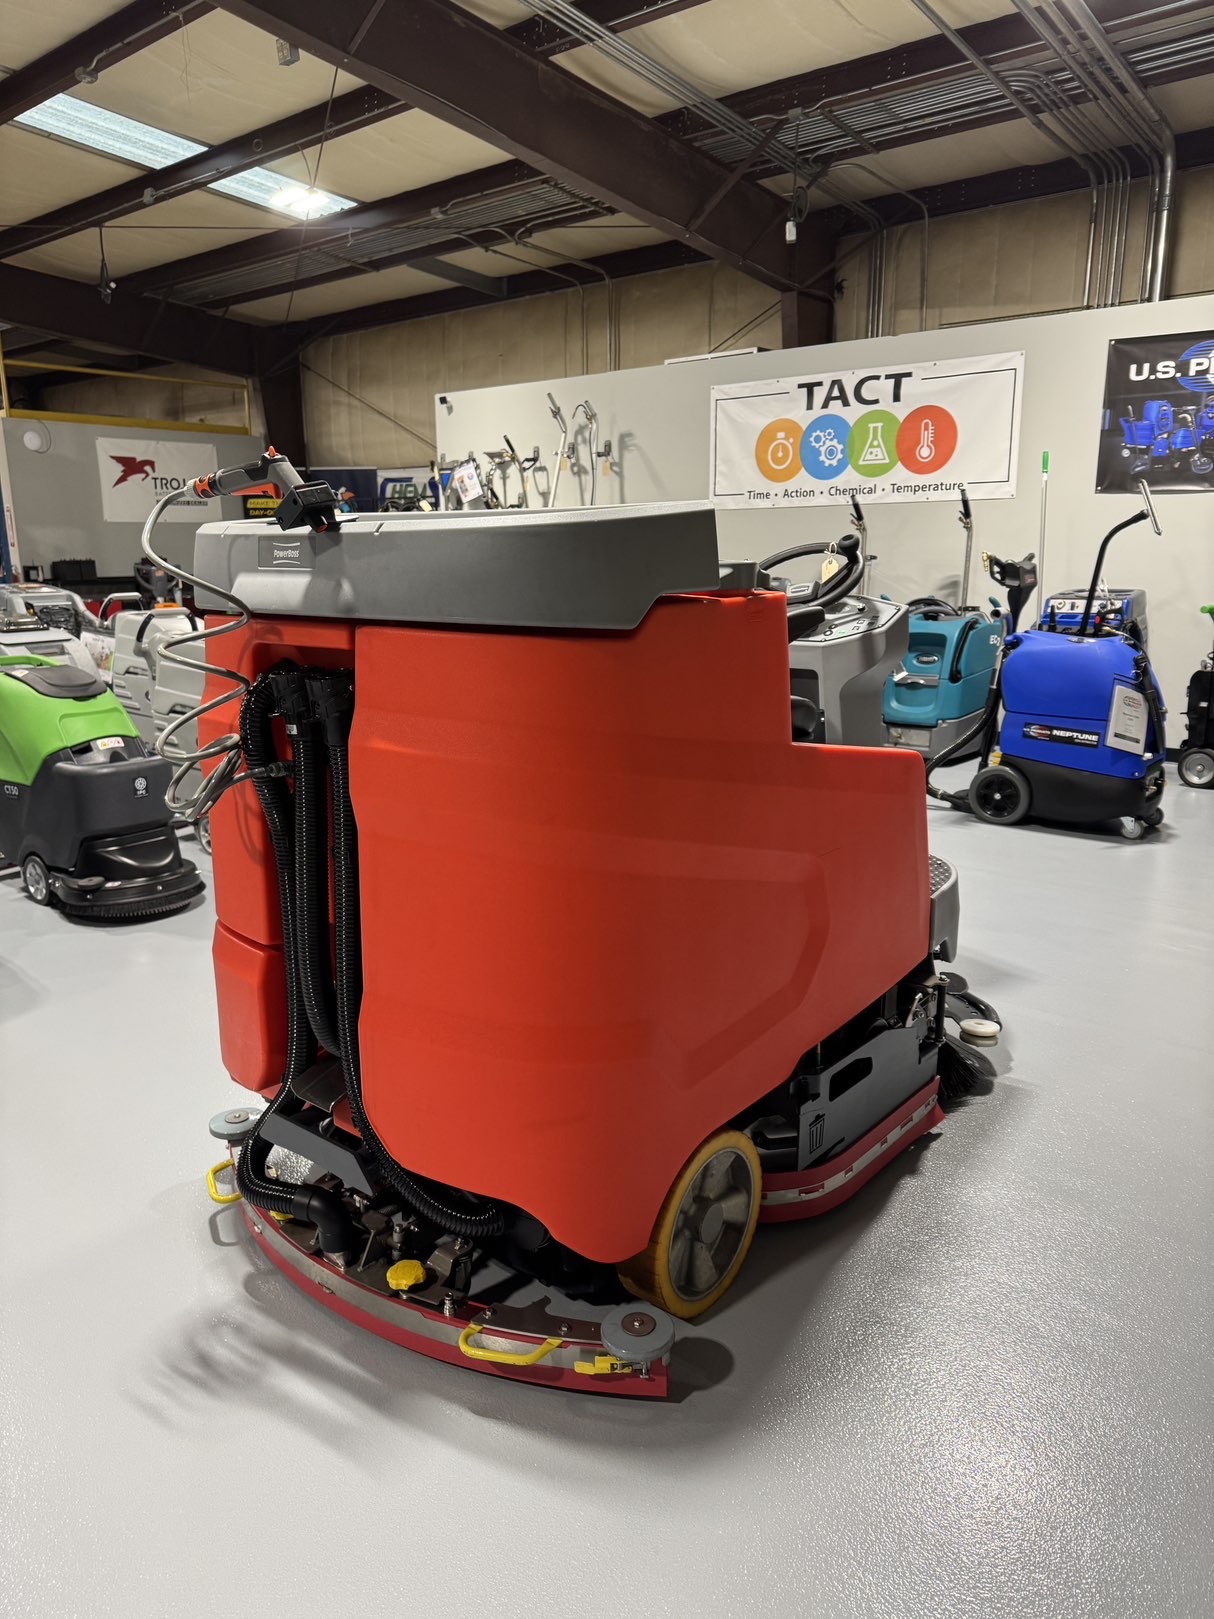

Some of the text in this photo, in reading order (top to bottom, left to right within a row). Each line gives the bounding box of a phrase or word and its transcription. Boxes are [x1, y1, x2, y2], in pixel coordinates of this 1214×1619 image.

[1128, 356, 1214, 381] U.S. P
[797, 371, 913, 411] TACT
[152, 477, 187, 490] TROJ
[747, 480, 964, 500] Time Action Chemical Temperature
[273, 549, 300, 558] PowerBoss
[1052, 729, 1099, 742] NEPTUNE
[4, 784, 19, 796] CT50
